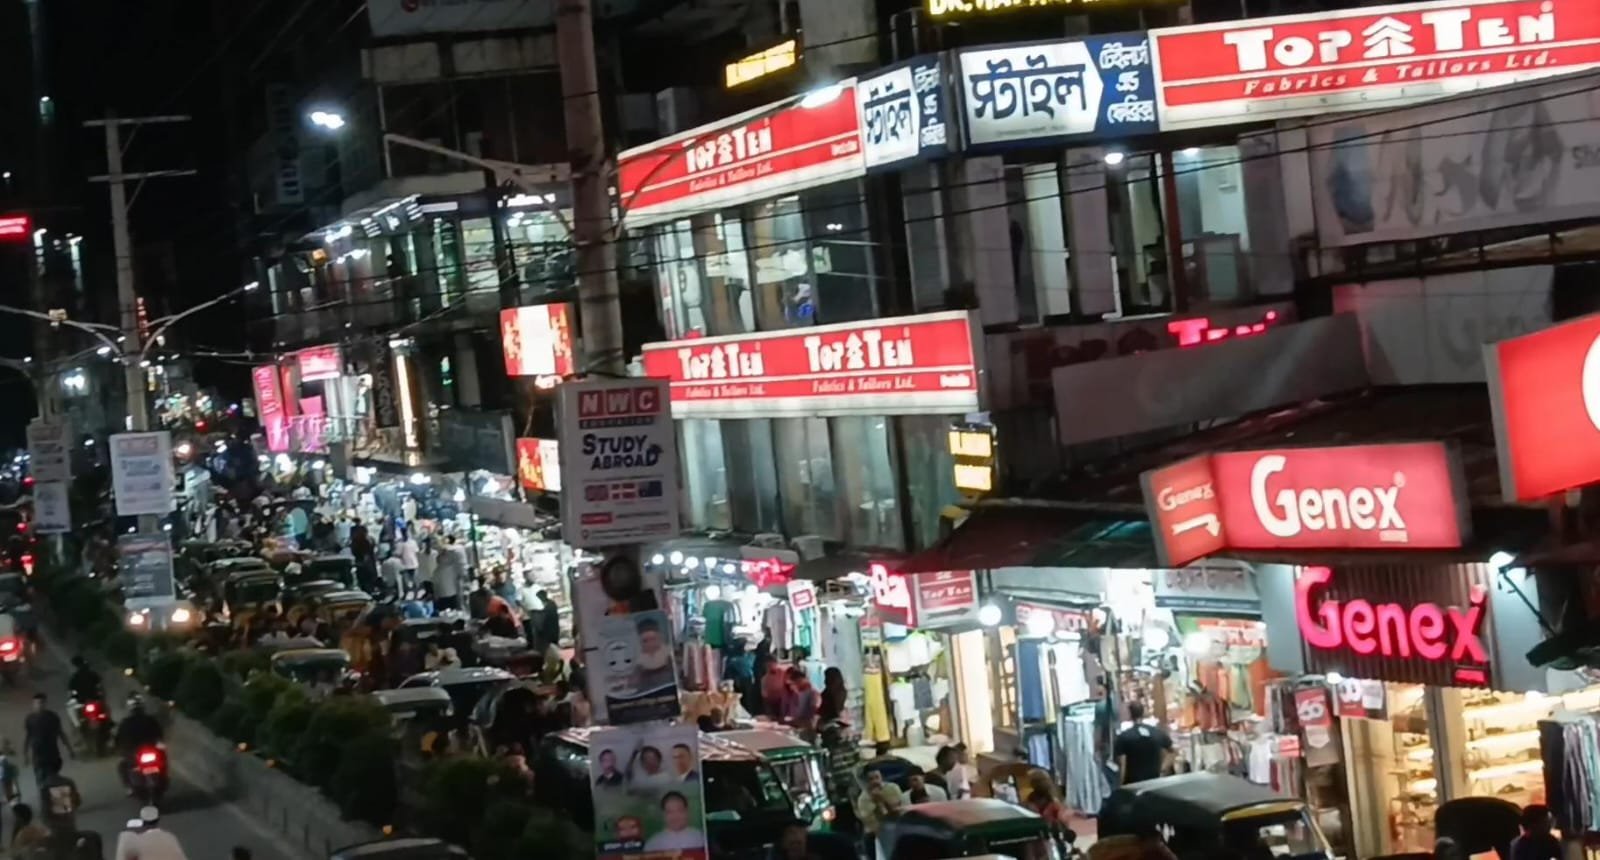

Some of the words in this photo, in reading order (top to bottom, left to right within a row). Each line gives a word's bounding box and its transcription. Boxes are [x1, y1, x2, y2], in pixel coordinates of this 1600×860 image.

[1223, 29, 1352, 72] TOP
[1243, 74, 1347, 95] Fabrics
[1362, 67, 1379, 82] &
[1397, 57, 1491, 79] Tailors
[1505, 50, 1558, 69] Ltd.
[969, 54, 1088, 120] স্টাইল
[864, 82, 914, 146] স্টাইল
[582, 390, 653, 414] NWC
[582, 434, 648, 455] STUDY
[591, 448, 660, 471] ABROAD
[1157, 482, 1215, 511] Genex
[1251, 455, 1405, 537] Genex
[1295, 566, 1488, 663] Genex
